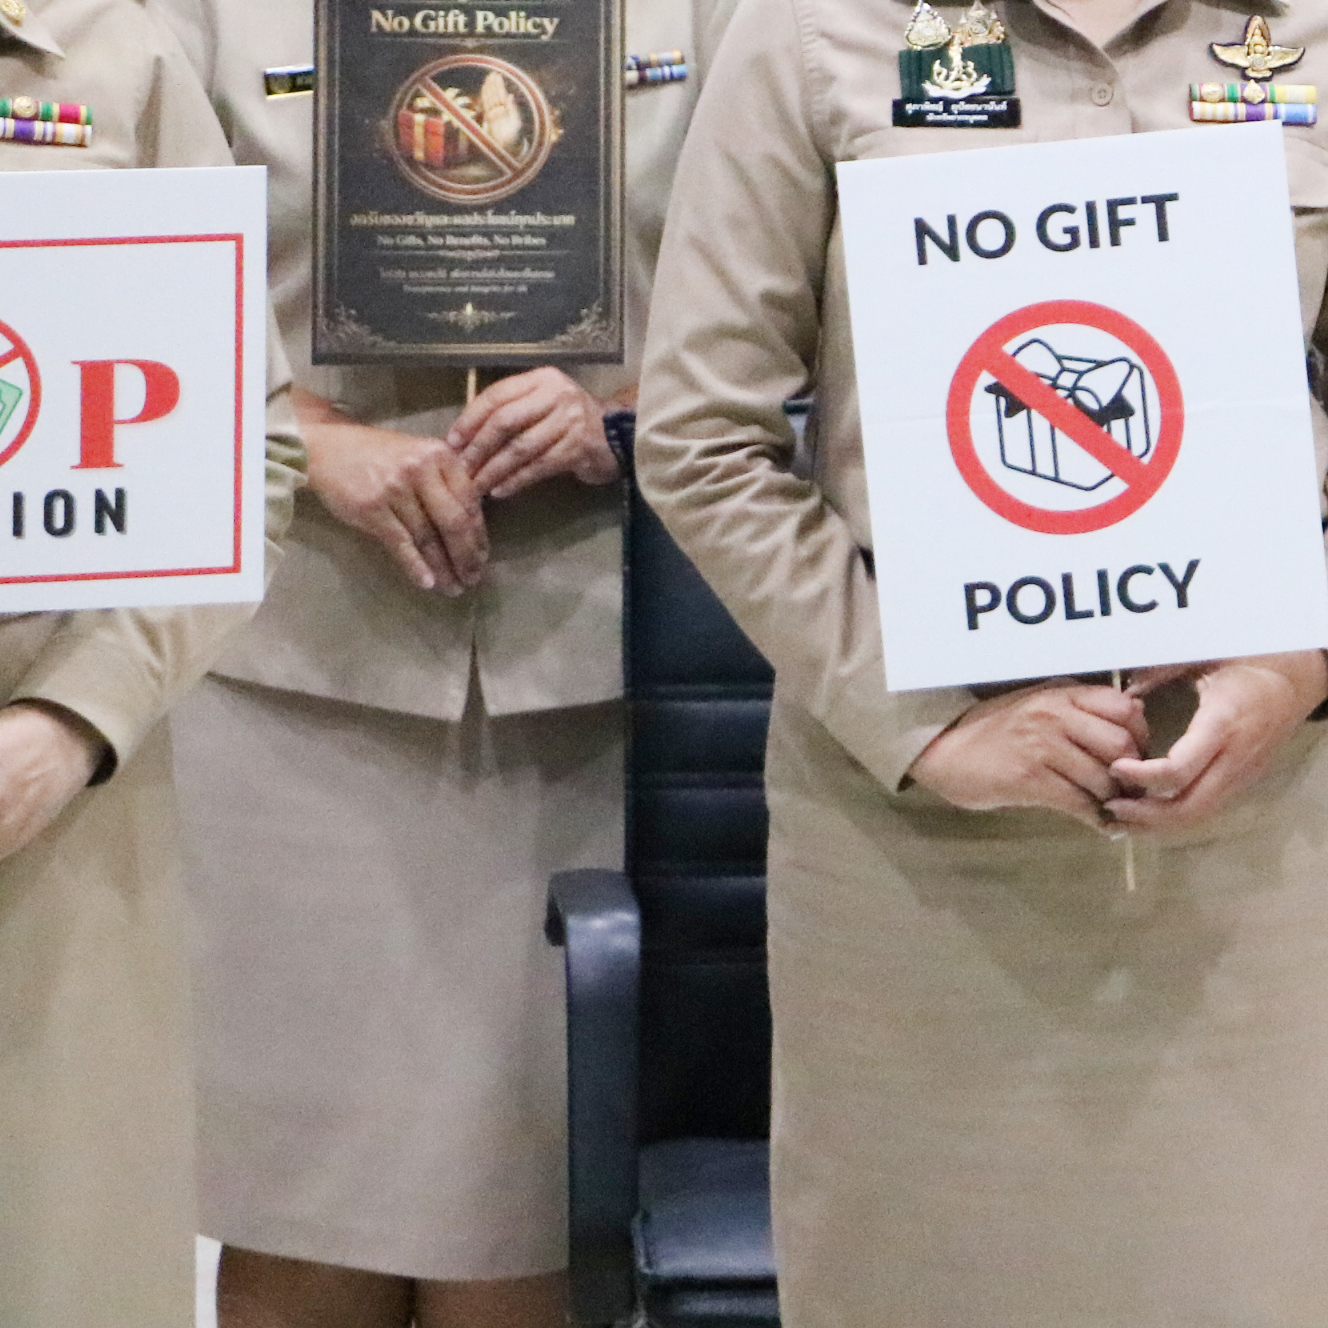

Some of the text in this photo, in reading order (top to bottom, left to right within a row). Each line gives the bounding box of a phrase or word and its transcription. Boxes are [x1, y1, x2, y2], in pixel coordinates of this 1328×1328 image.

[370, 9, 560, 40] No Gift Policy
[914, 193, 1180, 265] NO GIFT
[12, 487, 127, 539] ION
[963, 559, 1201, 630] POLICY
